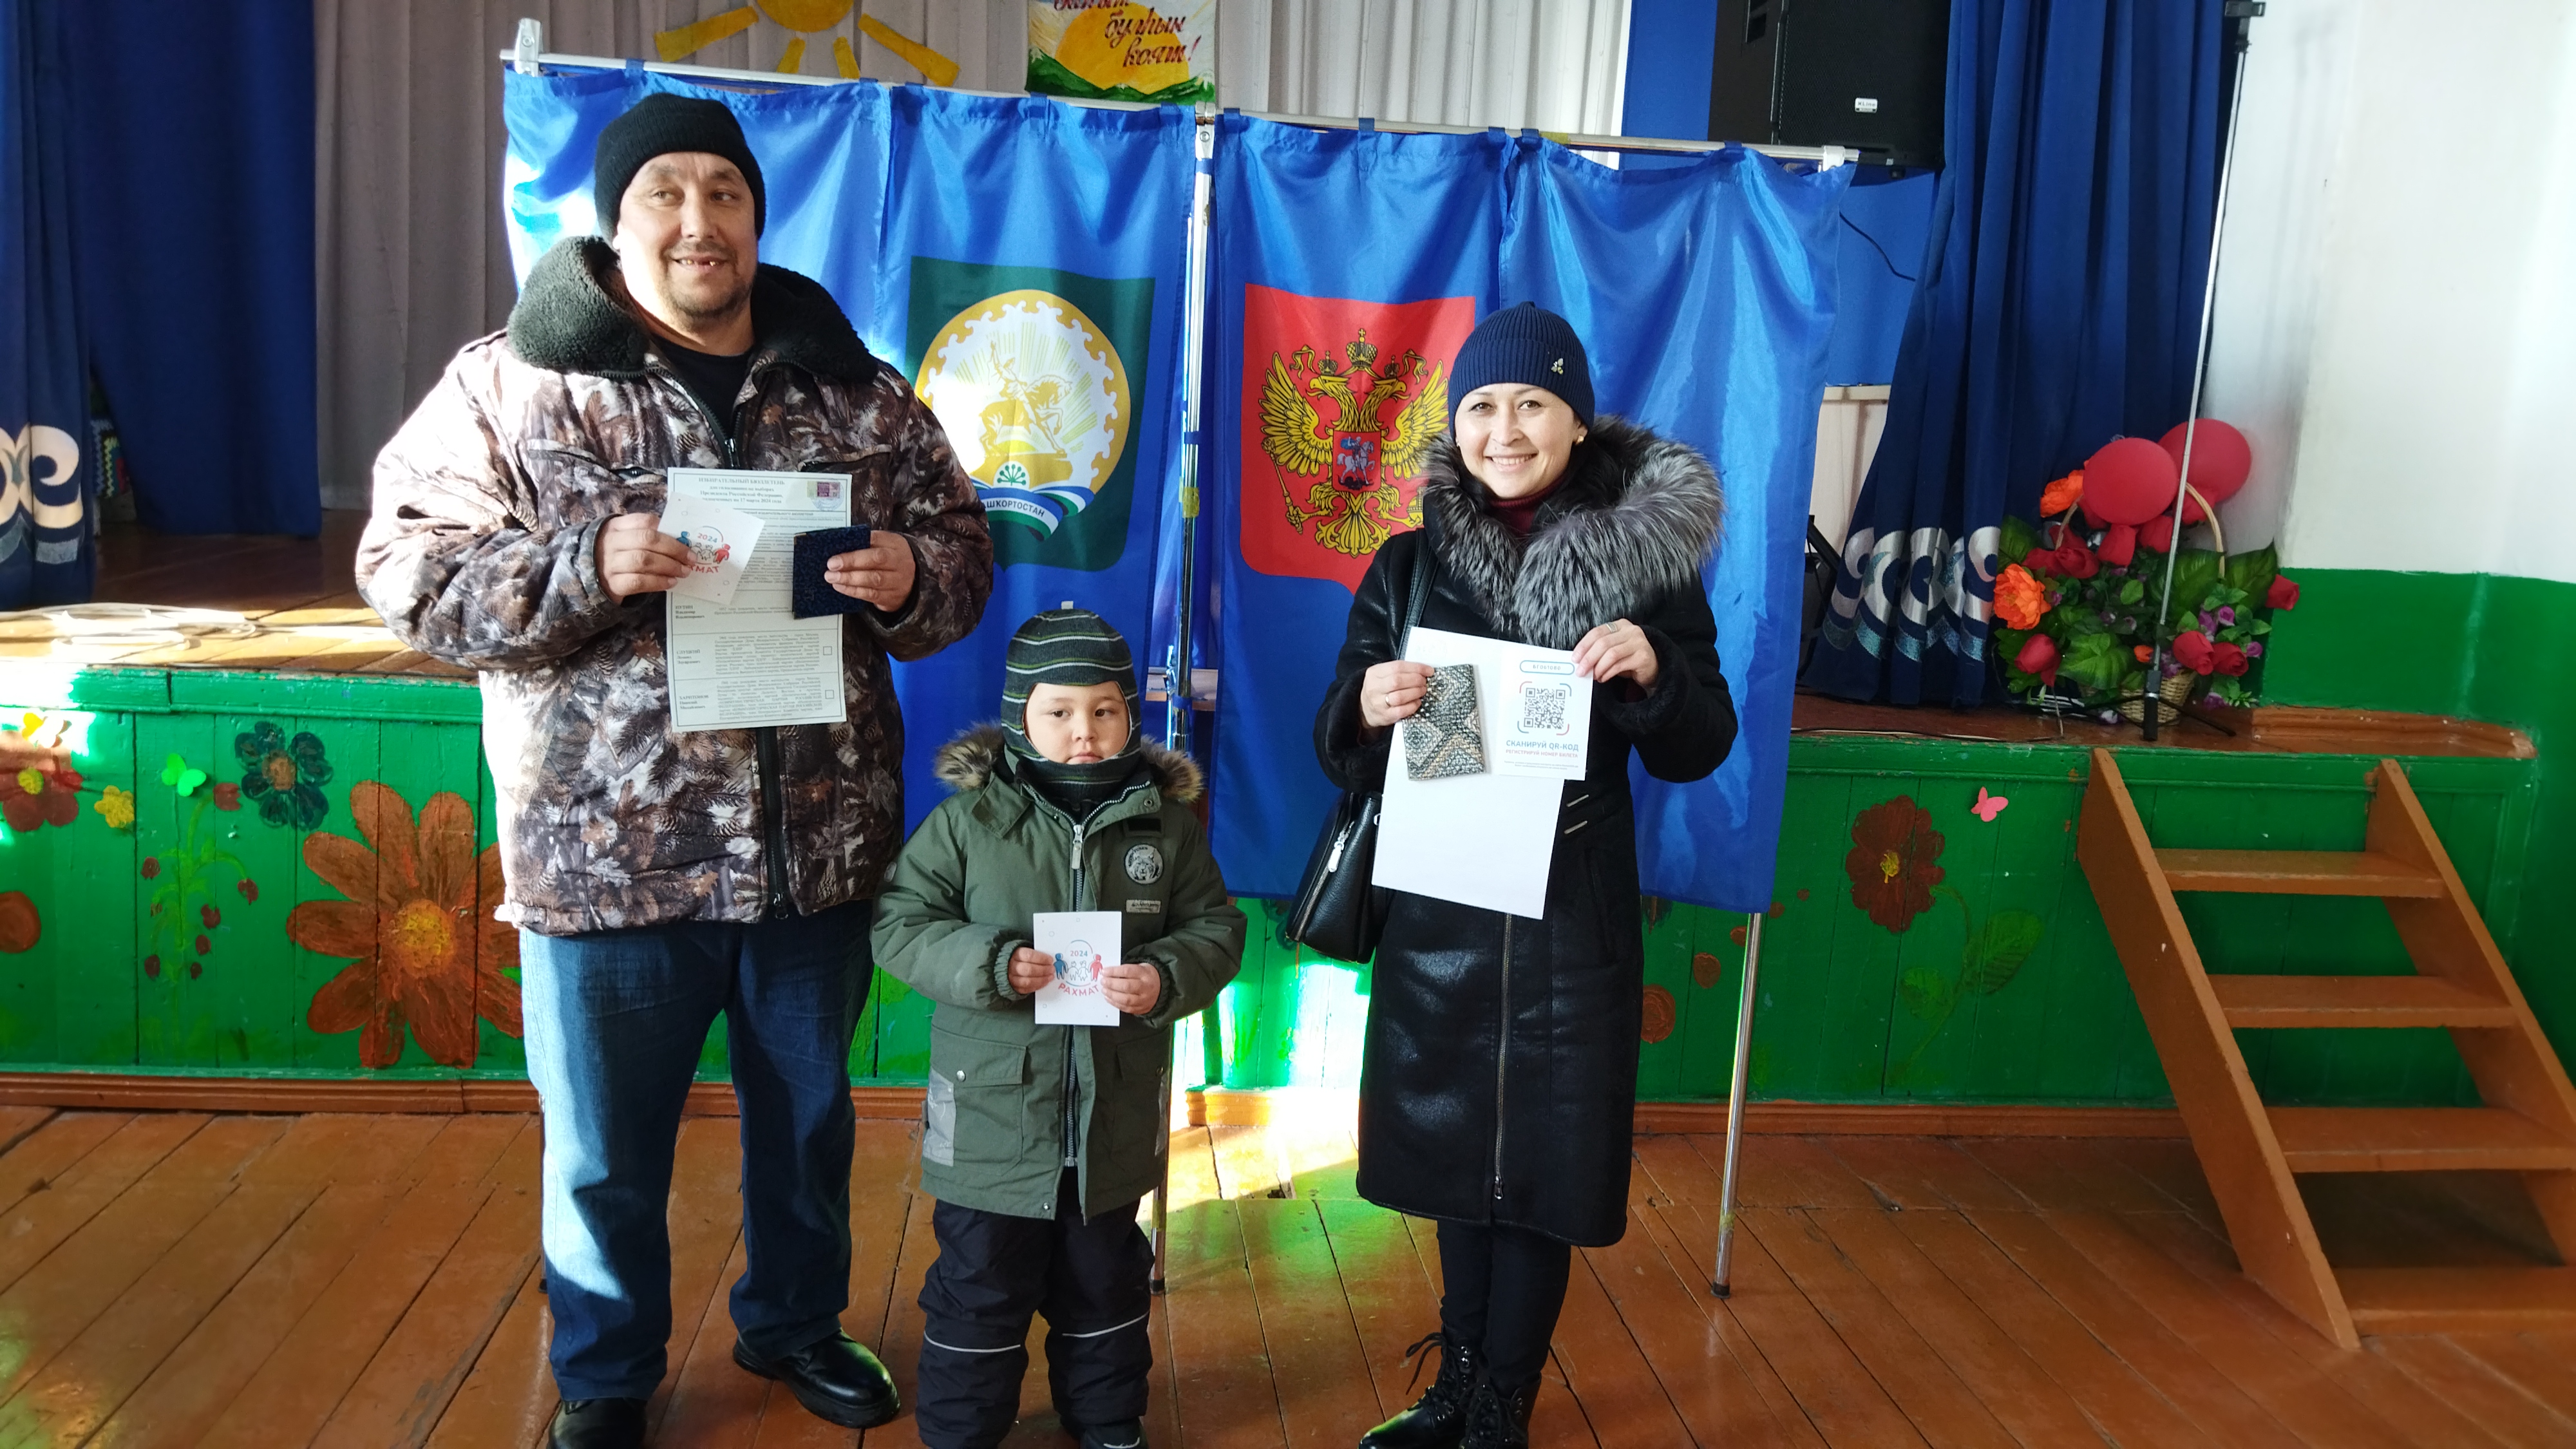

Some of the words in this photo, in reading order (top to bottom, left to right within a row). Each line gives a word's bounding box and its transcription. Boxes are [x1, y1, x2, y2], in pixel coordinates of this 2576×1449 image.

[697, 533, 717, 543] 2024
[1506, 740, 1547, 748] СКАНИРУЙ
[1549, 743, 1579, 752] QR-КОД
[1058, 982, 1099, 996] РАХМАТ
